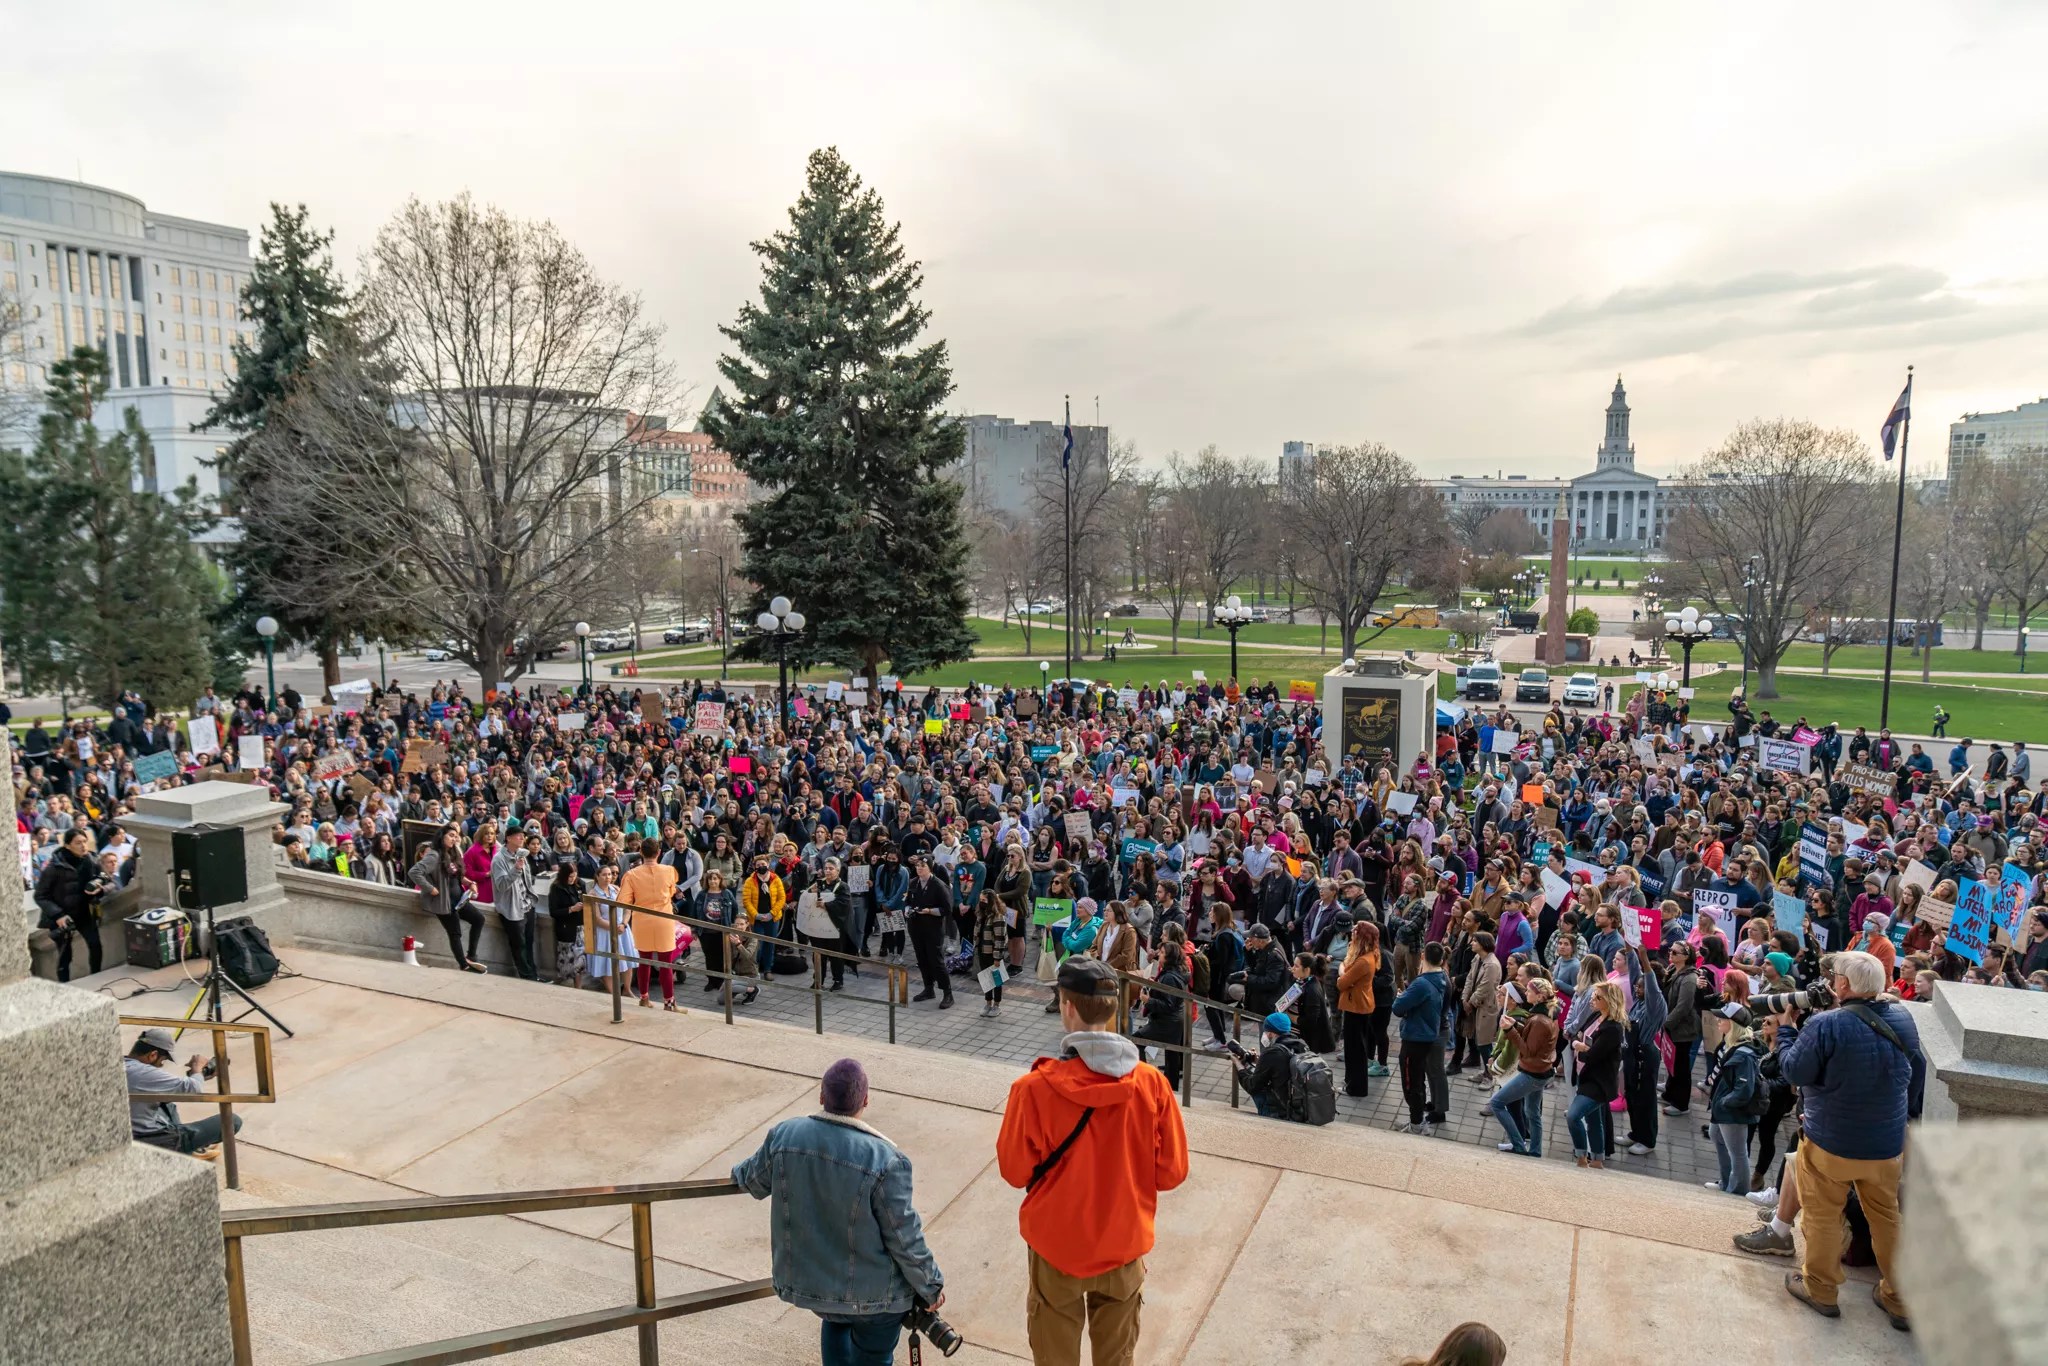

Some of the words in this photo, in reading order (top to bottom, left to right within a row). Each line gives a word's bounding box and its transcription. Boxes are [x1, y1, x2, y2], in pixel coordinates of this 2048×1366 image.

[1841, 773, 1864, 786] KILLS
[1852, 765, 1892, 782] PRO-LIFE
[1865, 779, 1892, 795] WOMEN
[1803, 827, 1826, 843] BENNET
[1802, 846, 1824, 860] BENNET
[1801, 863, 1822, 879] BENNET
[1695, 889, 1729, 905] REPRO
[1639, 914, 1653, 923] We
[1695, 904, 1732, 922] RTS
[1676, 917, 1692, 928] NNE
[1963, 916, 1983, 933] MY
